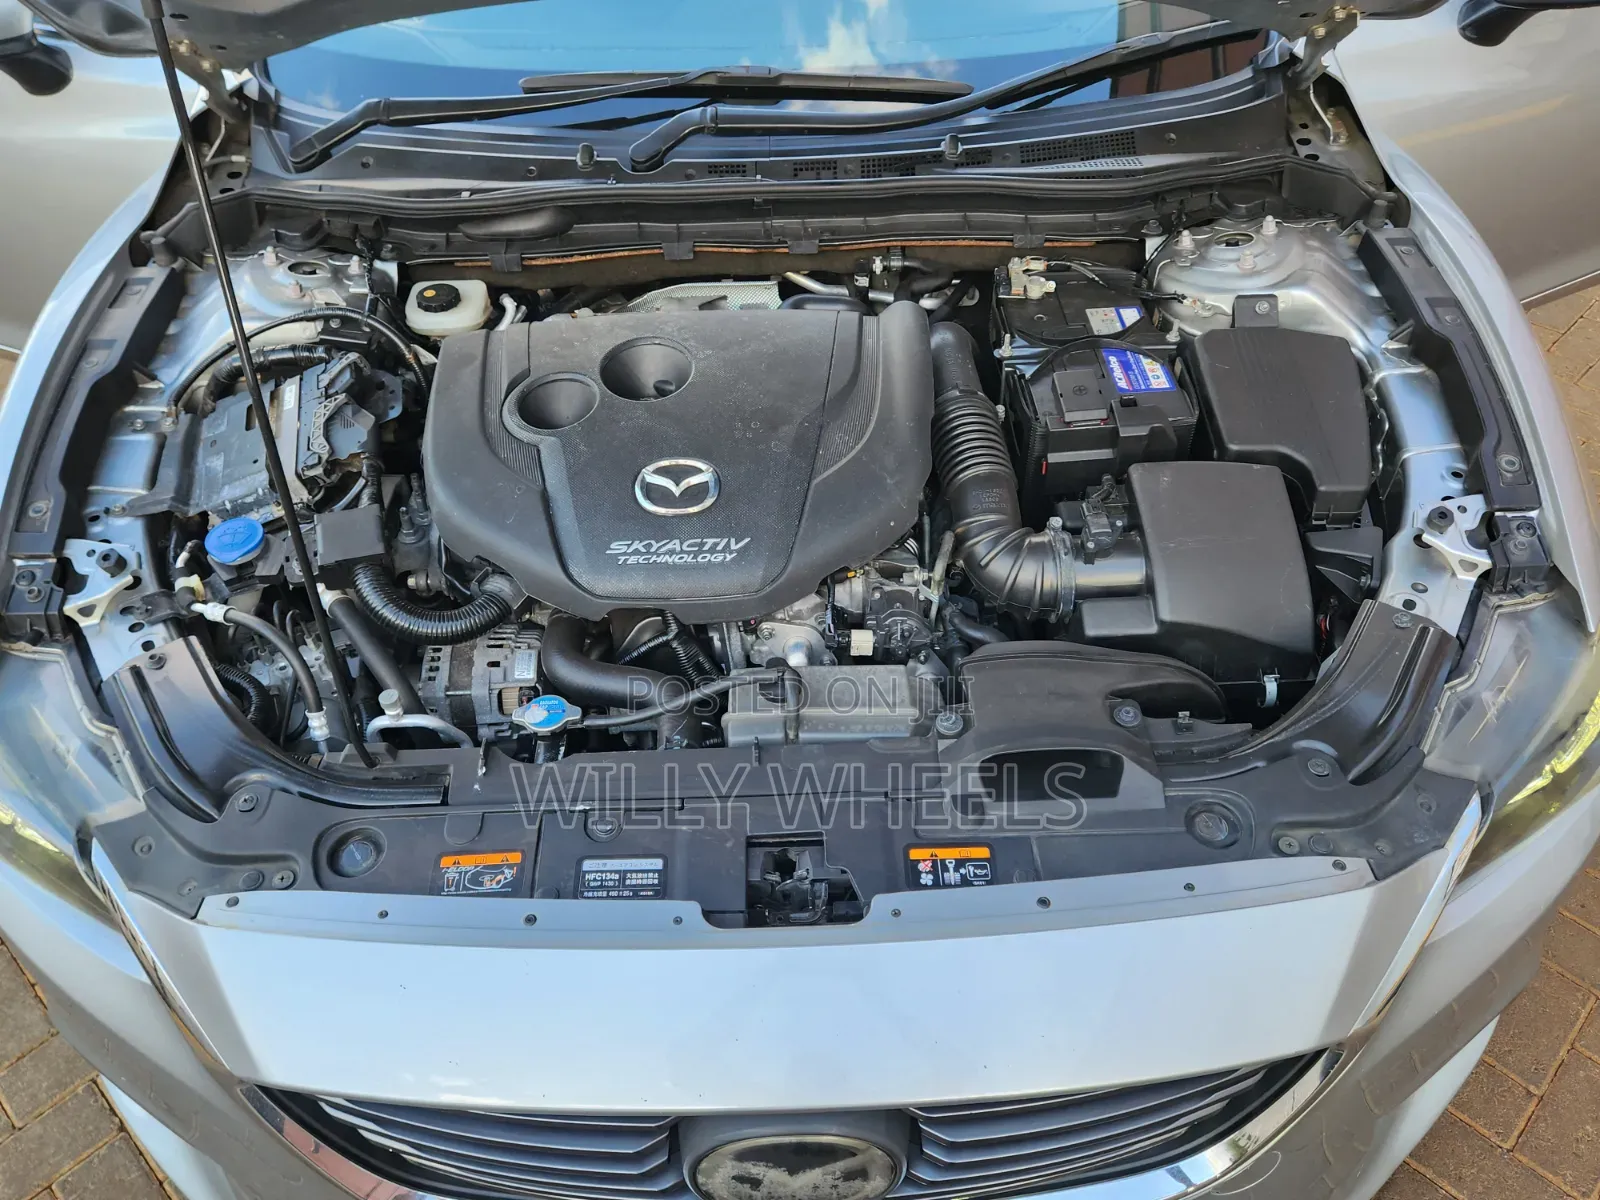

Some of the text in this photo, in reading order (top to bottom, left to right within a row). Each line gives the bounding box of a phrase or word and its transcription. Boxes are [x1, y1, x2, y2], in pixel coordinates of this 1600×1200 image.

[605, 537, 751, 554] SKYACTIV
[617, 553, 738, 565] TECHNOLOGY
[585, 872, 619, 881] HFC134a
